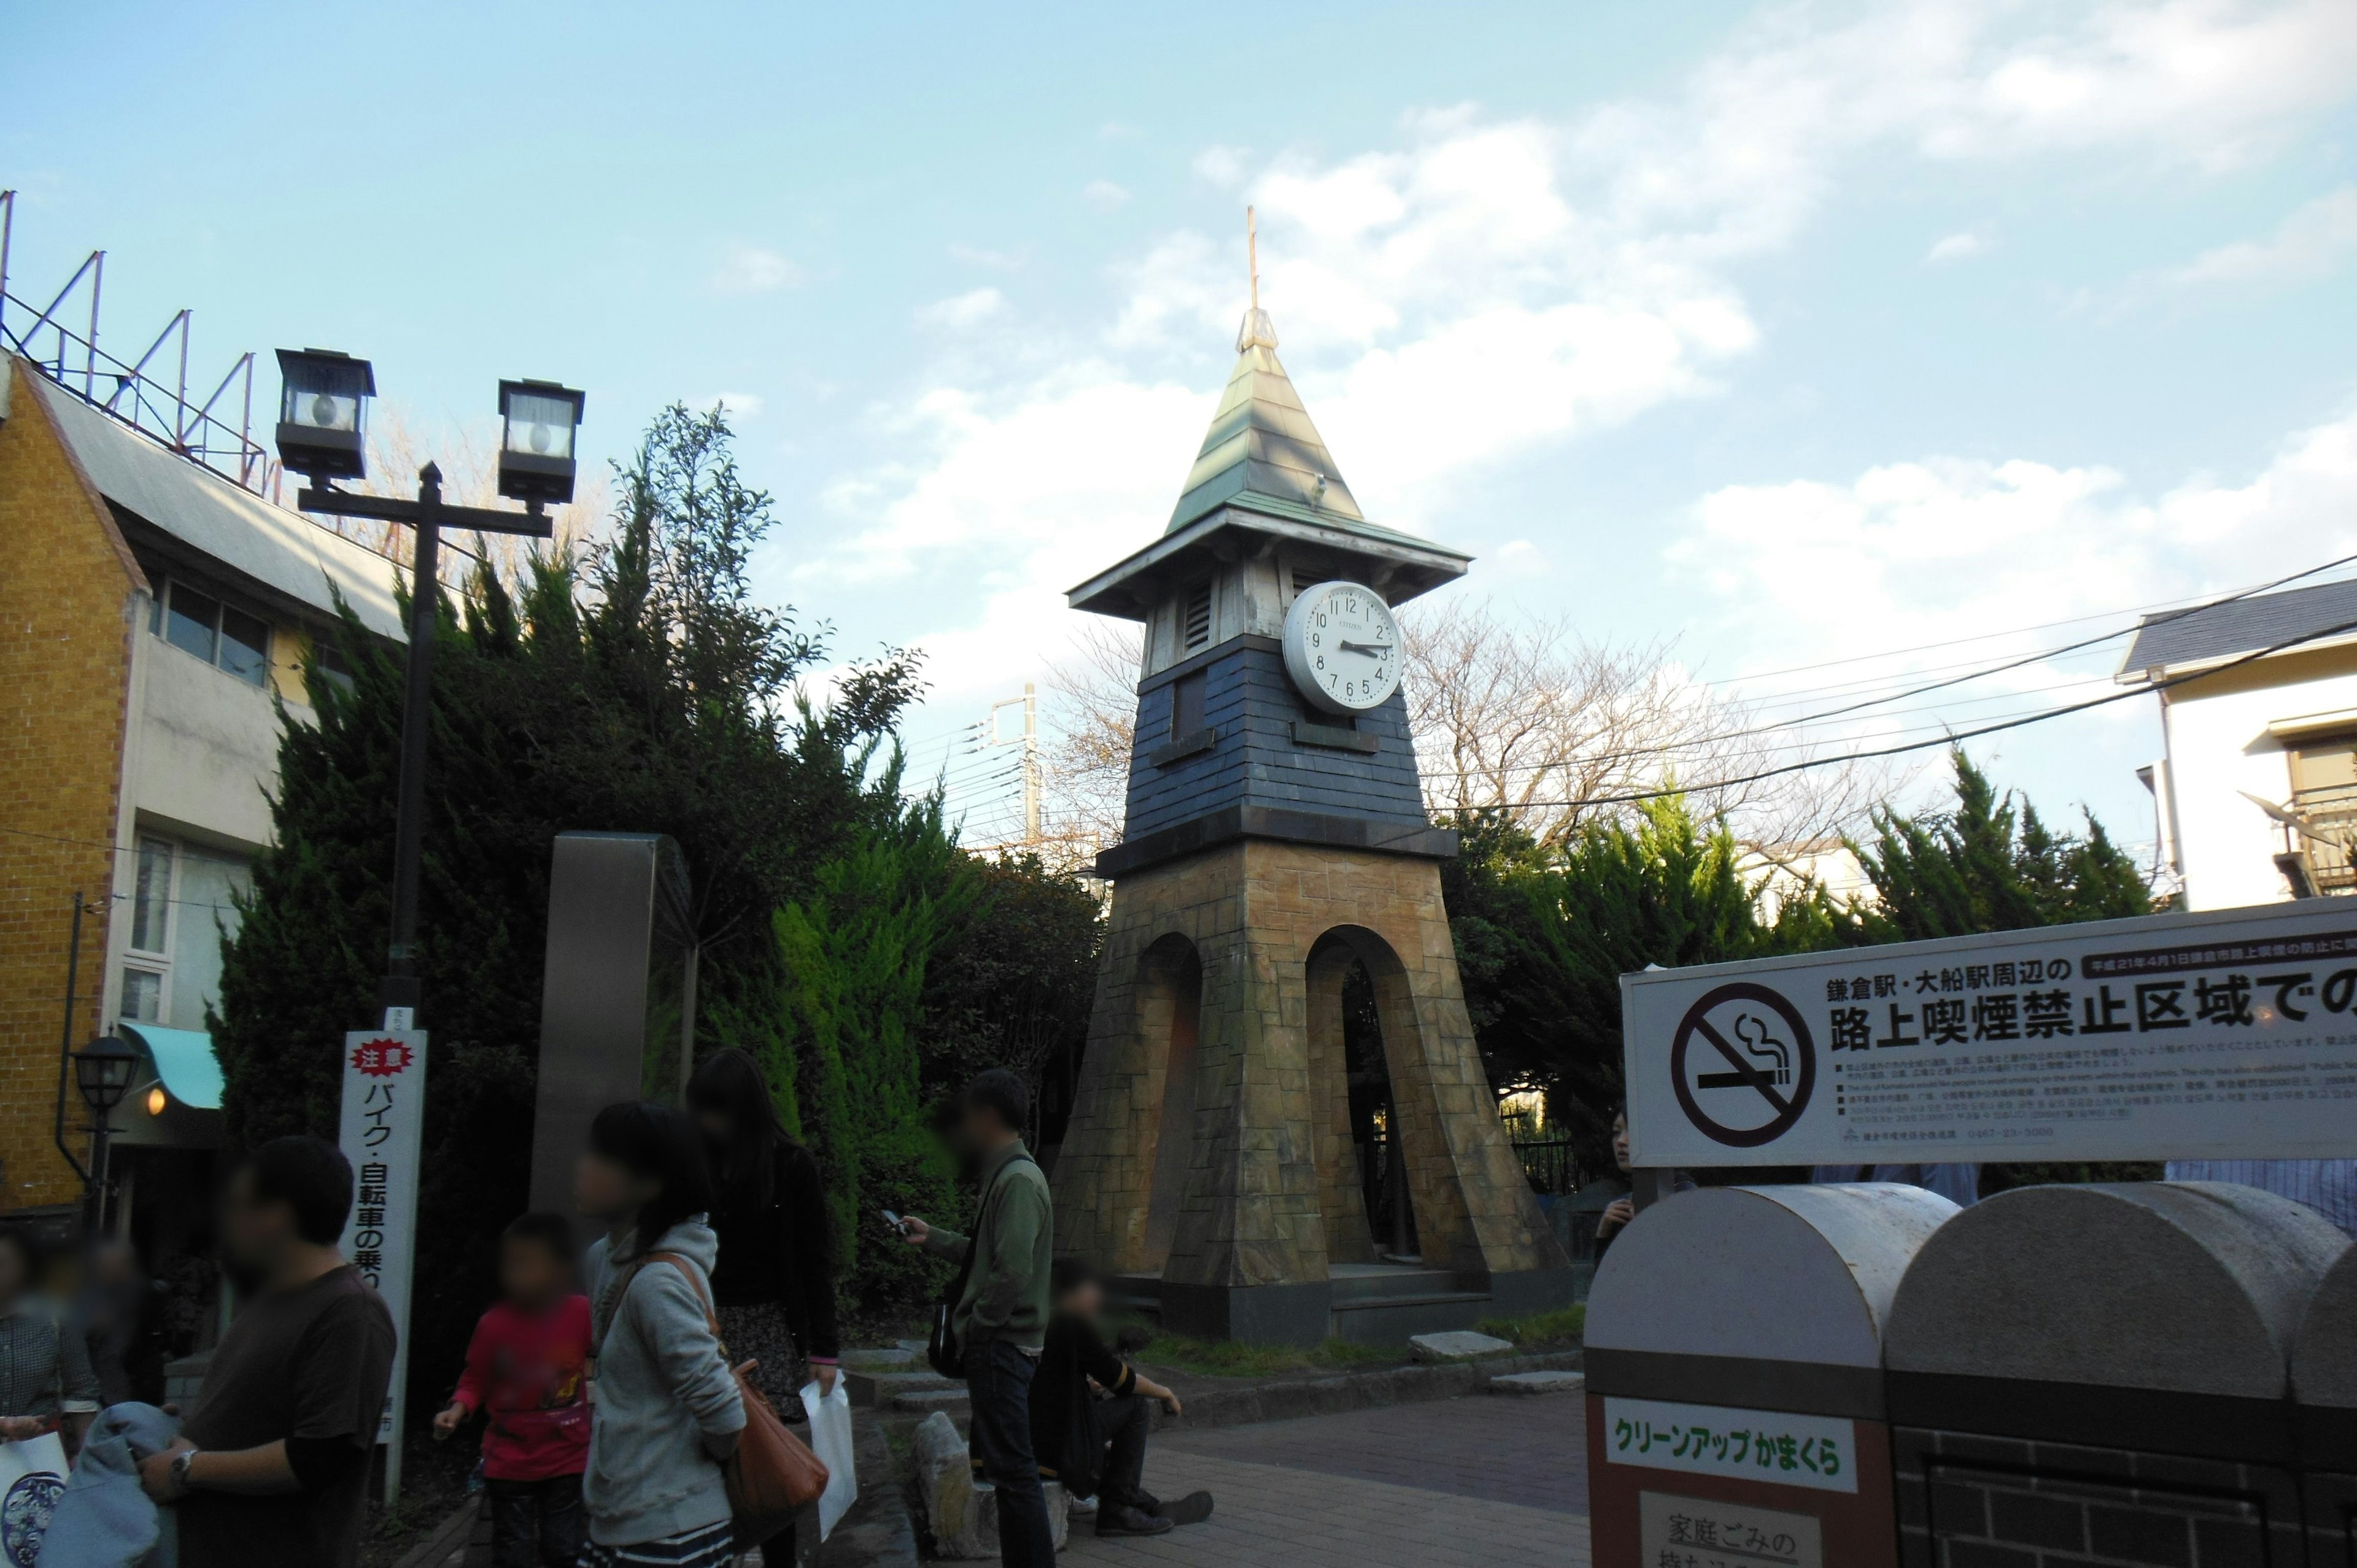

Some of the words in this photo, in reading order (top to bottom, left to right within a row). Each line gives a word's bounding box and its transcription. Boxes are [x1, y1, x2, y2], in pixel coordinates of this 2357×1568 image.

[1331, 600, 1337, 615] 11
[1346, 598, 1356, 613] 12
[1317, 612, 1326, 627] 10
[1339, 620, 1361, 631] CITIZEN
[1377, 625, 1382, 639] 2
[1313, 633, 1319, 647] 9
[1380, 648, 1387, 660] 3
[1317, 655, 1324, 670] 8
[1331, 674, 1337, 688] 7
[1375, 667, 1383, 681] 4
[1347, 682, 1353, 696] 6
[1363, 680, 1369, 693] 5
[1827, 958, 2072, 1002] 鎌倉駅・大船駅周辺の
[1830, 968, 2357, 1052] 路上喫煙禁止区域での
[361, 1047, 403, 1068] 注意
[1614, 1418, 1840, 1475] クリーンアップかまくら
[1668, 1513, 1796, 1554] 家庭ごみの
